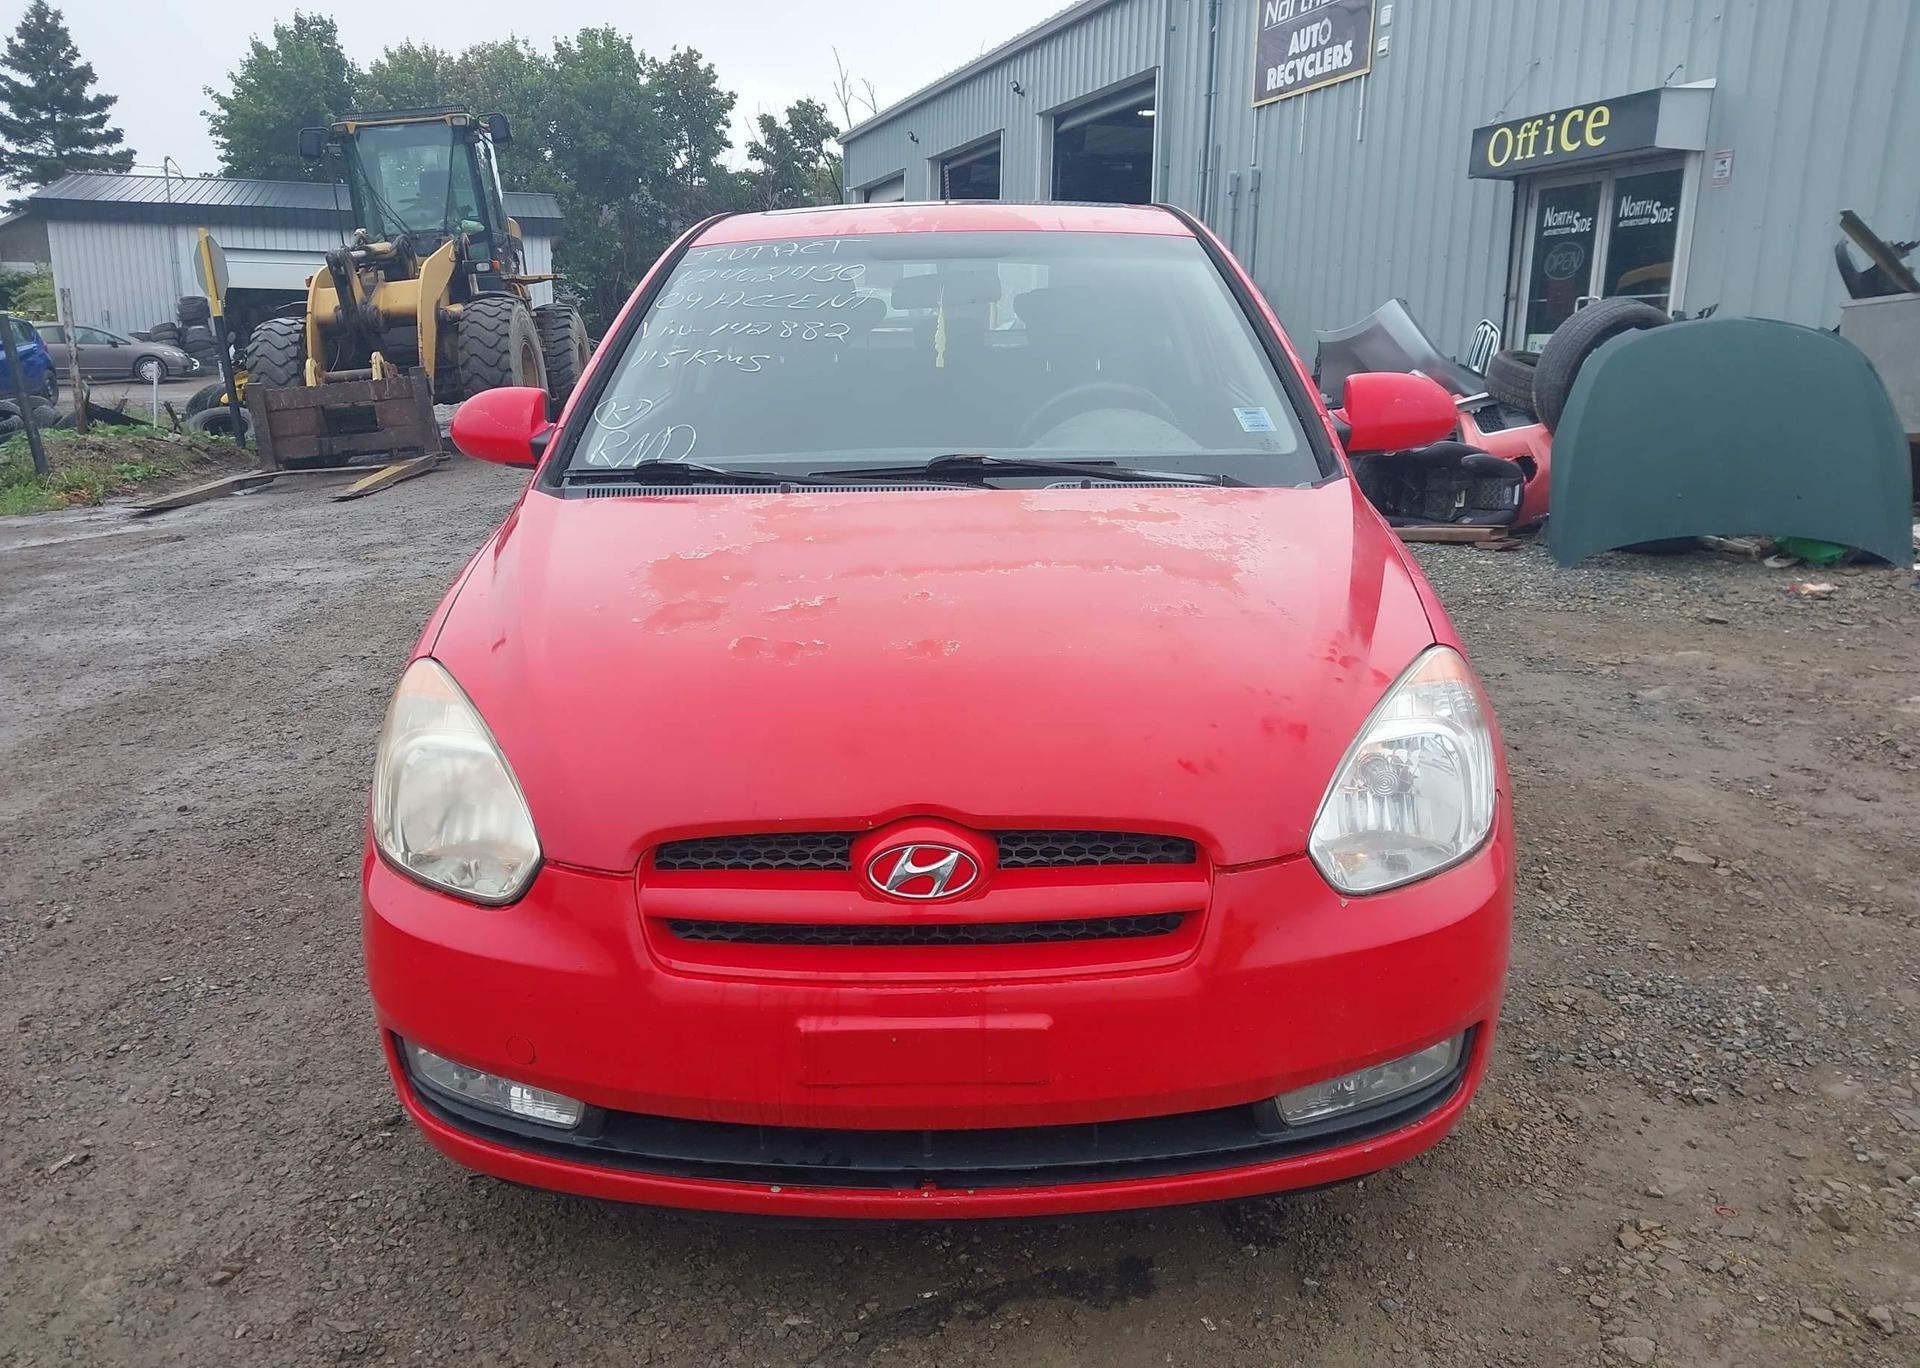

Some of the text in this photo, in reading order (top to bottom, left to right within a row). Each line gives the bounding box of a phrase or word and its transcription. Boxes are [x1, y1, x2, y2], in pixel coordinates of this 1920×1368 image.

[1288, 17, 1332, 56] AUTO
[1266, 40, 1353, 91] RECYCLERS
[1487, 104, 1610, 167] Office
[1543, 206, 1573, 227] NORTH
[1571, 211, 1592, 233] SIDE
[1619, 195, 1654, 218] NORTH
[1650, 201, 1675, 224] SIDE
